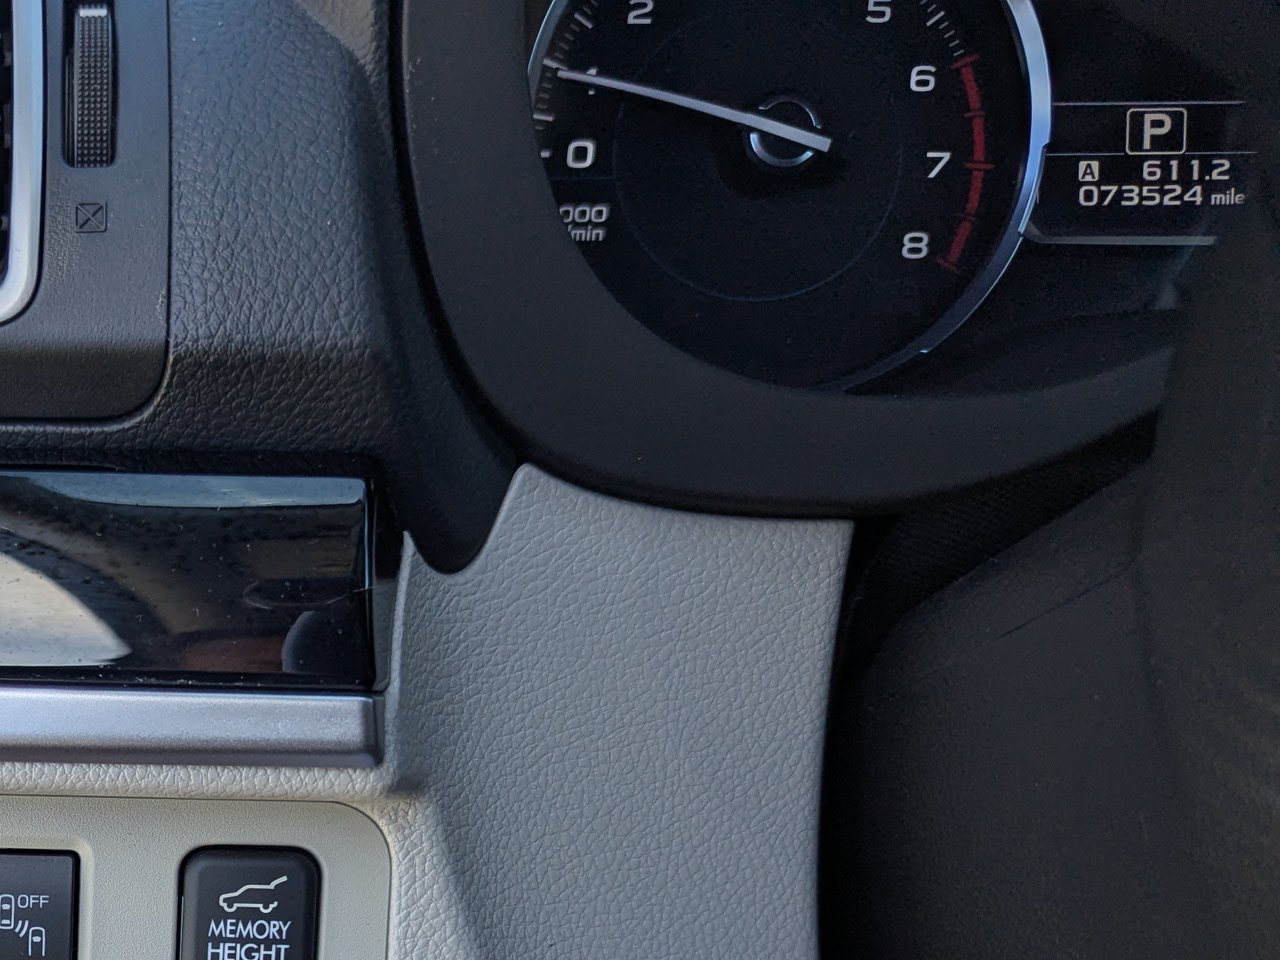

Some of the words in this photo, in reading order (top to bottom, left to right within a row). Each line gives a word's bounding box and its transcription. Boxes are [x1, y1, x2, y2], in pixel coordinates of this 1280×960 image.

[627, 0, 654, 25] 2
[865, 0, 893, 24] 5
[909, 65, 937, 92] 6
[1142, 113, 1172, 150] P
[566, 139, 596, 169] 0
[926, 152, 952, 179] 7
[1142, 159, 1231, 181] 611.2
[1078, 184, 1203, 206] 073524
[1210, 187, 1246, 206] mile
[901, 231, 930, 260] 8
[17, 894, 50, 909] OFF
[207, 918, 292, 940] MEMORY
